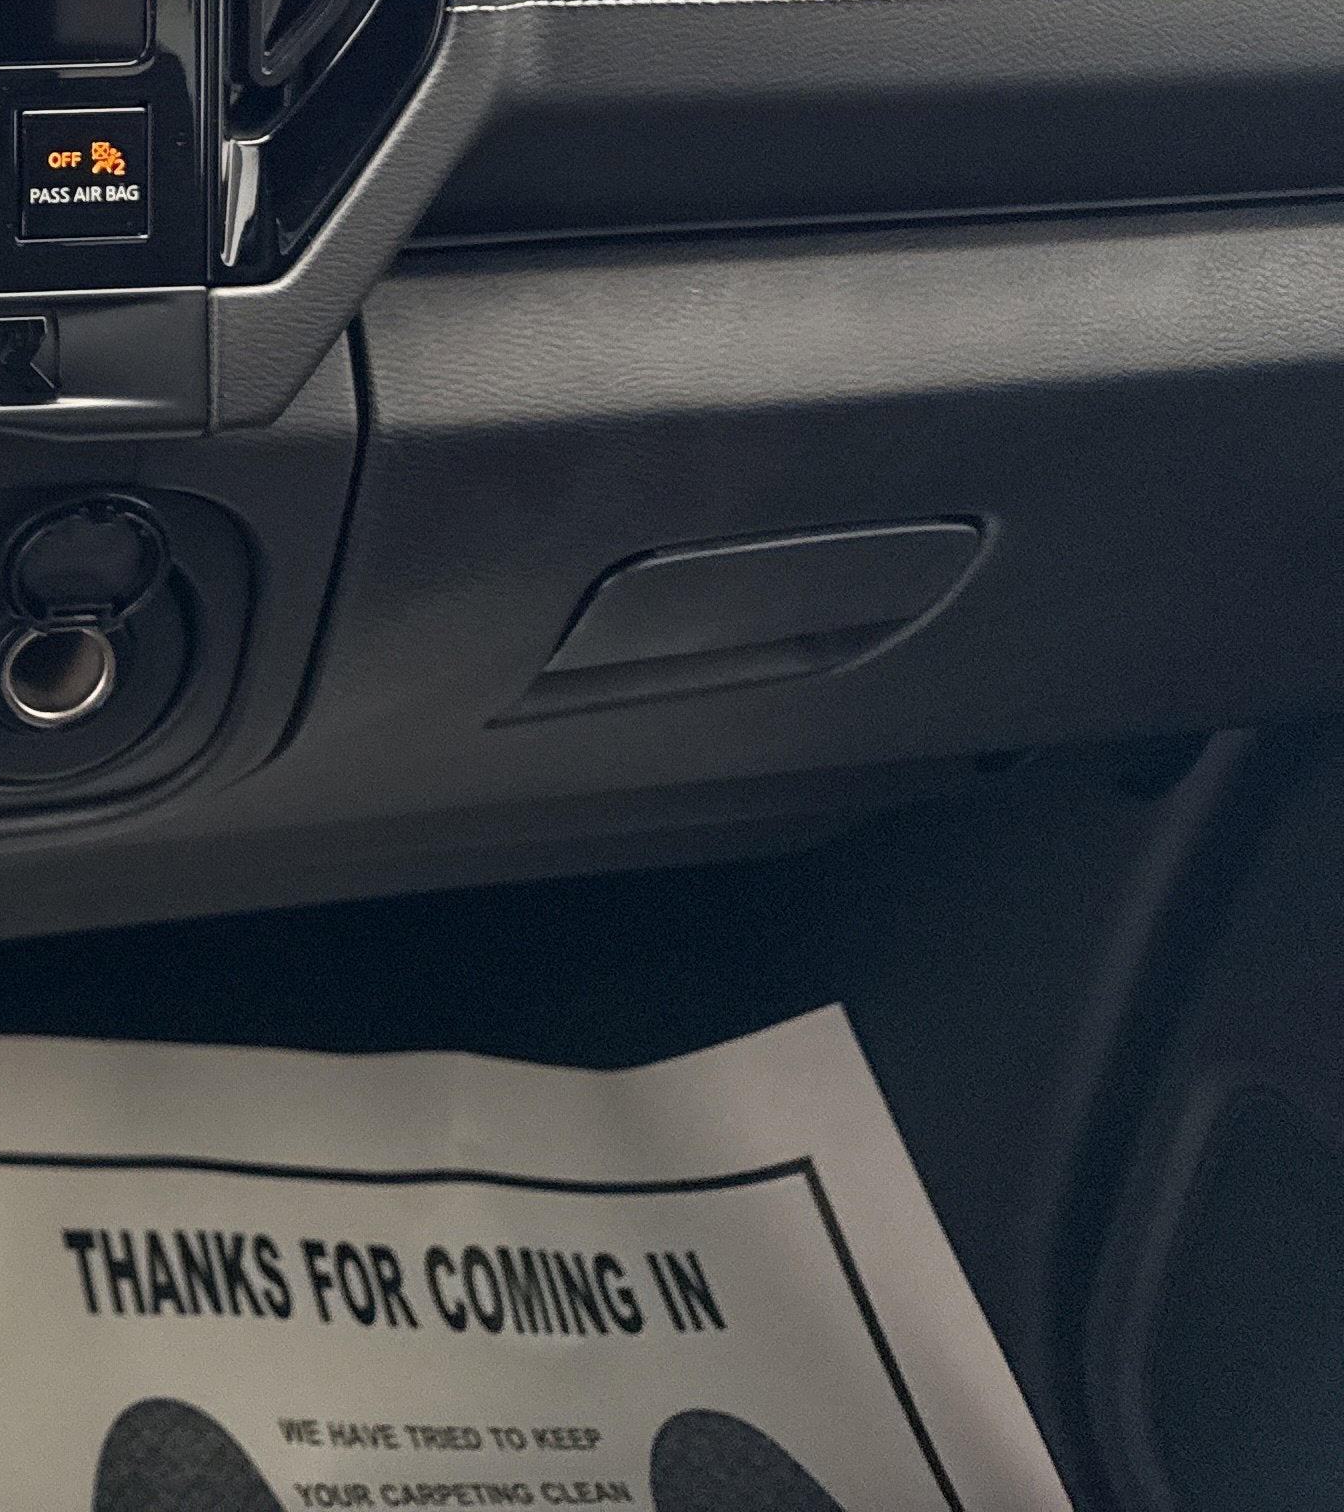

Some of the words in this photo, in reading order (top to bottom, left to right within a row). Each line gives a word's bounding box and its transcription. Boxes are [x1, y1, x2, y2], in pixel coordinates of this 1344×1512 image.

[48, 151, 82, 169] OFF
[30, 187, 70, 205] PASS
[72, 186, 103, 203] AIR
[105, 184, 140, 202] BAG
[64, 1229, 292, 1321] THANKS
[300, 1240, 422, 1330] FOR
[425, 1244, 645, 1336] COMING
[648, 1249, 727, 1333] IN
[279, 1418, 323, 1446] WE
[326, 1421, 400, 1450] HAVE
[404, 1423, 482, 1451] TRIED
[490, 1426, 528, 1451] TO
[531, 1426, 604, 1452] KEEP
[295, 1482, 375, 1509] YOUR
[380, 1482, 534, 1507] CARPETING
[540, 1481, 634, 1505] CLEAN
